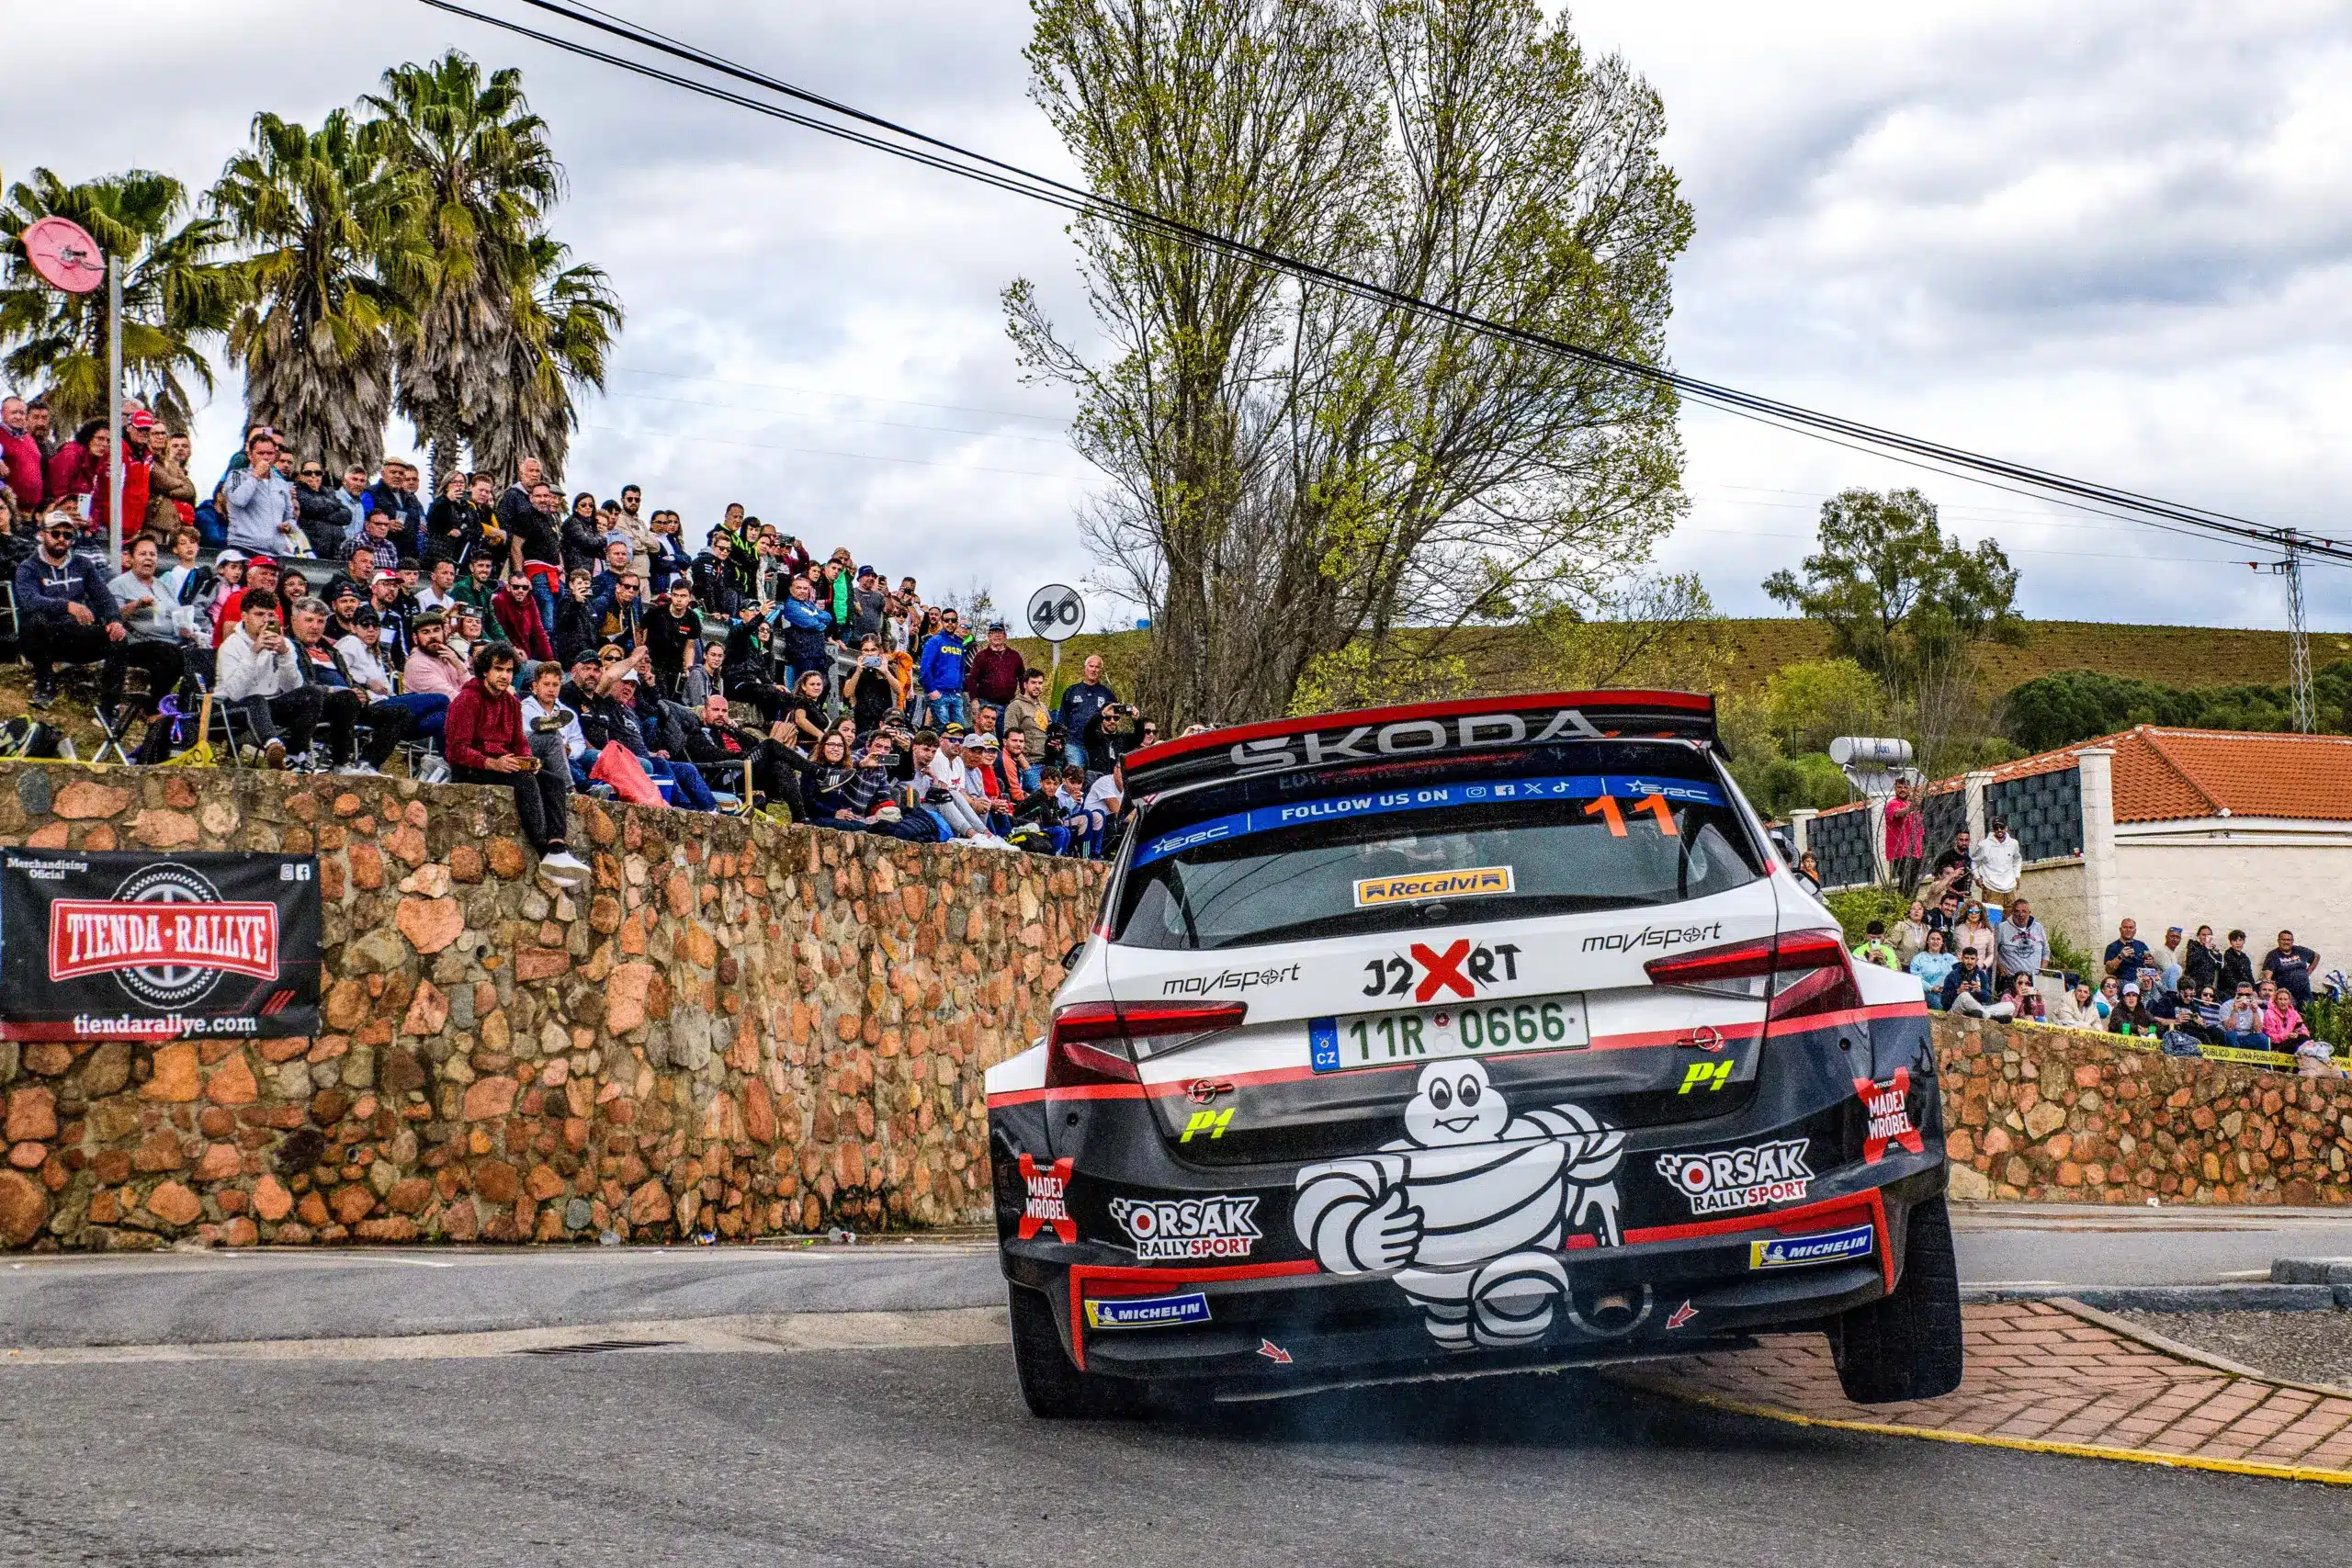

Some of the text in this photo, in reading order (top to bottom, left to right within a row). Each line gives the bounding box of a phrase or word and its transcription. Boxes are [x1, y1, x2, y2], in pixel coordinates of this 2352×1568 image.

[1033, 600, 1080, 626] 40
[1282, 797, 1373, 820] FOLLOW
[1379, 792, 1410, 807] US
[1417, 788, 1449, 804] ON
[1584, 793, 1679, 838] 11
[6, 857, 88, 873] Merchandising
[29, 869, 66, 880] Oficial
[1388, 874, 1479, 897] Recalvi
[67, 914, 268, 964] TIENDA RALLYE
[1582, 921, 1723, 953] movisport
[1163, 962, 1302, 996] movisport
[1362, 939, 1522, 1003] J2XRT
[74, 1014, 257, 1038] tiendarallye.com
[1350, 1001, 1566, 1060] 11R 0666
[2133, 1039, 2151, 1048] ZONA
[2234, 1050, 2253, 1061] ZONA
[1316, 1051, 1337, 1066] CZ
[1678, 1059, 1735, 1094] P1
[1868, 1090, 1905, 1118] MADEJ
[1180, 1107, 1236, 1144] P1
[1027, 1176, 1064, 1199] MADEJ
[1693, 1180, 1805, 1212] RALLYSPORT
[1139, 1238, 1250, 1257] RALLYSPORT
[1789, 1235, 1867, 1258] MICHELIN
[1118, 1303, 1201, 1321] MICHELIN
